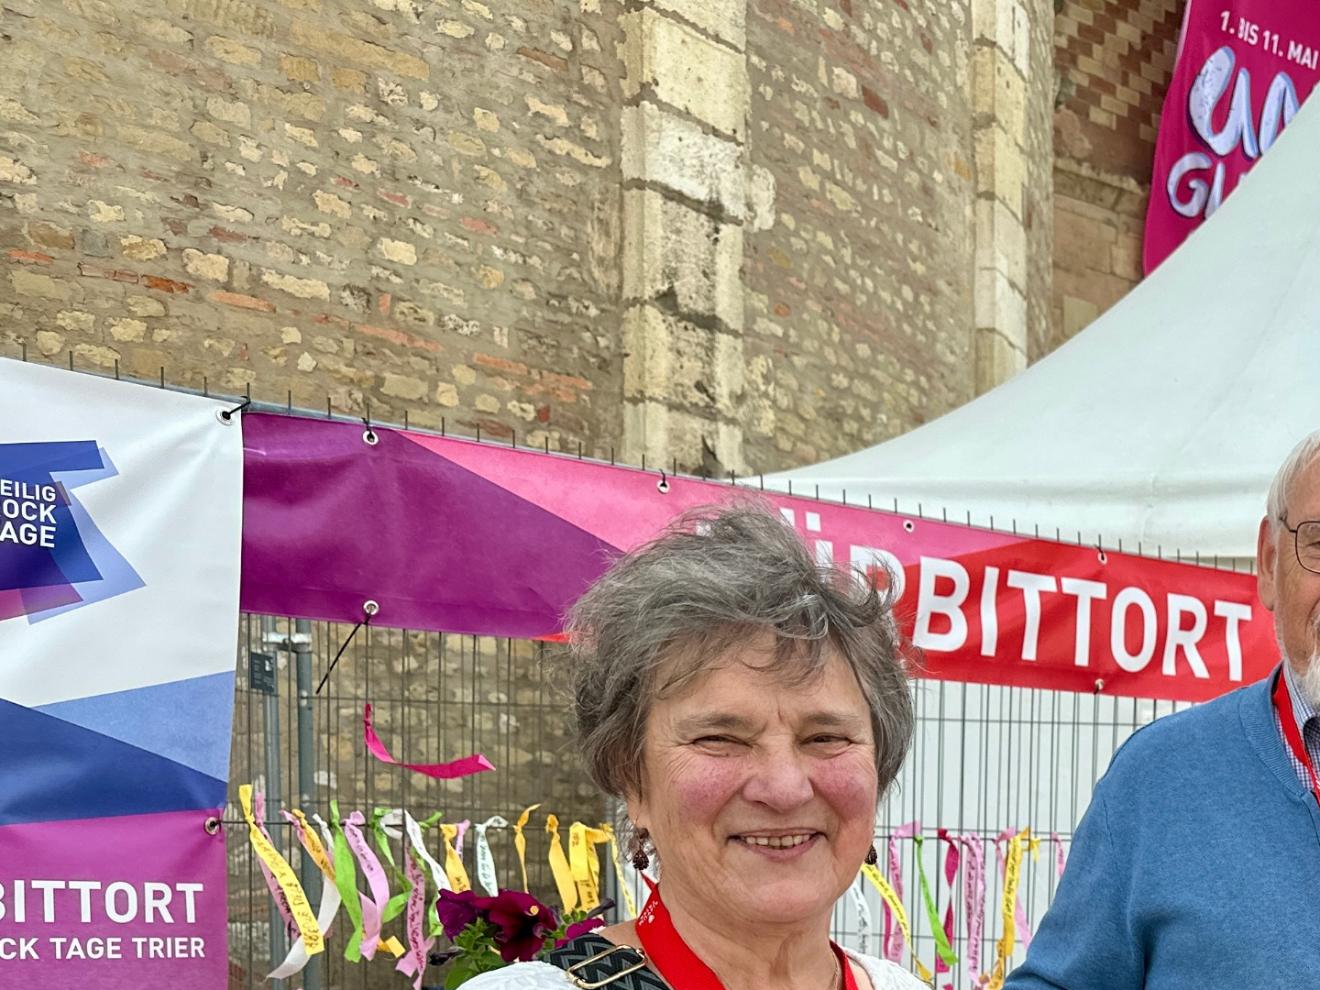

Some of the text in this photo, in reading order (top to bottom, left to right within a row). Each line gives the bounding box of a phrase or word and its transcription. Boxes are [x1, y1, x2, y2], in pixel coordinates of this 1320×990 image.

[1219, 10, 1320, 70] 1. BIS 11. MAI
[0, 478, 57, 502] EILIG
[0, 498, 57, 524] OCK
[0, 520, 57, 548] AGE
[0, 879, 205, 924] ITTORT
[0, 937, 206, 960] CK TAGE TRIER
